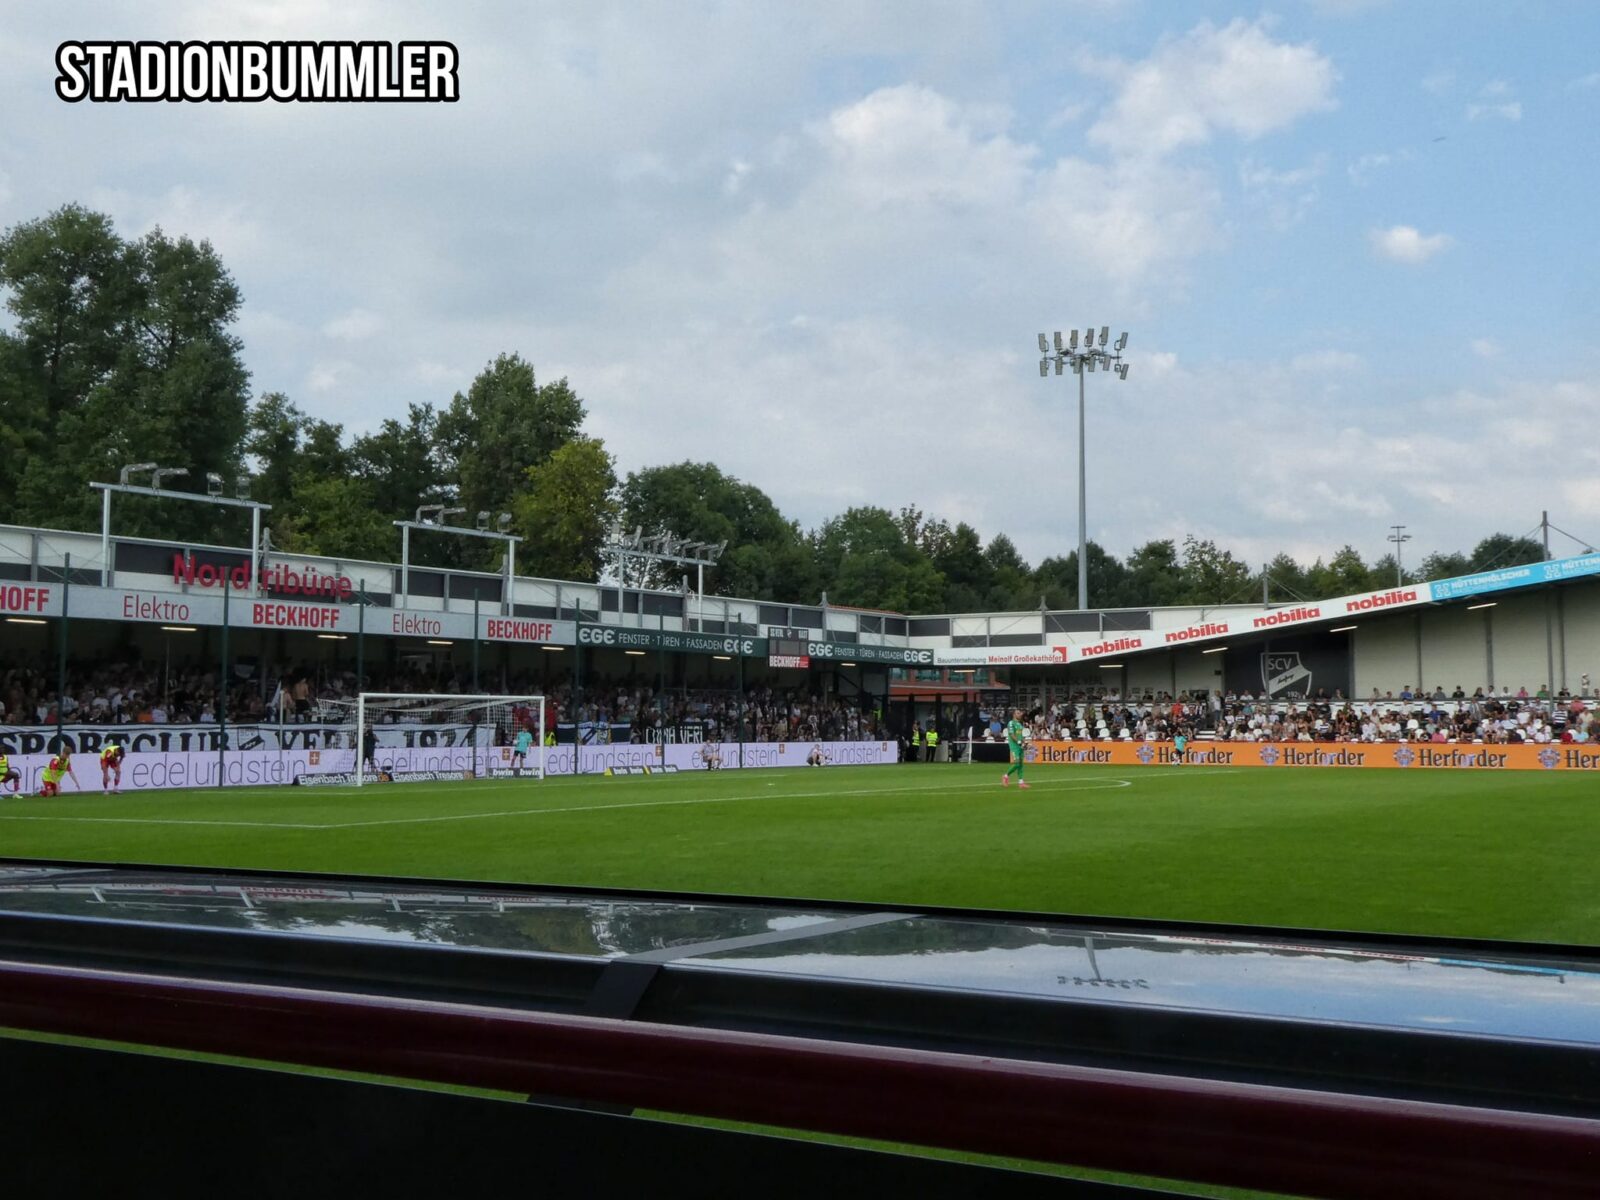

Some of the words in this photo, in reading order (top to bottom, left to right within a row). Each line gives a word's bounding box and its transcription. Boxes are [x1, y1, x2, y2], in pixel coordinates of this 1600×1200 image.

[173, 553, 352, 599] Nordribüne
[123, 595, 190, 621] Elektro
[1346, 591, 1417, 612] nobilia
[253, 603, 340, 629] BECKHOFF
[392, 613, 441, 636] Elektro
[1253, 607, 1321, 628] nobilia
[487, 619, 552, 641] BECKHOFF
[1165, 622, 1229, 643] nobilia
[618, 632, 650, 645] FENSTER
[686, 638, 723, 651] FASSADEN
[1081, 637, 1142, 657] nobilia
[834, 647, 856, 657] FENSTER
[988, 655, 1013, 664] Meinolf
[1269, 658, 1292, 670] SCV
[1042, 745, 1112, 763] Herforder
[1284, 747, 1365, 766] Herforder
[1419, 748, 1507, 768] Herforder
[493, 768, 514, 776] bwin
